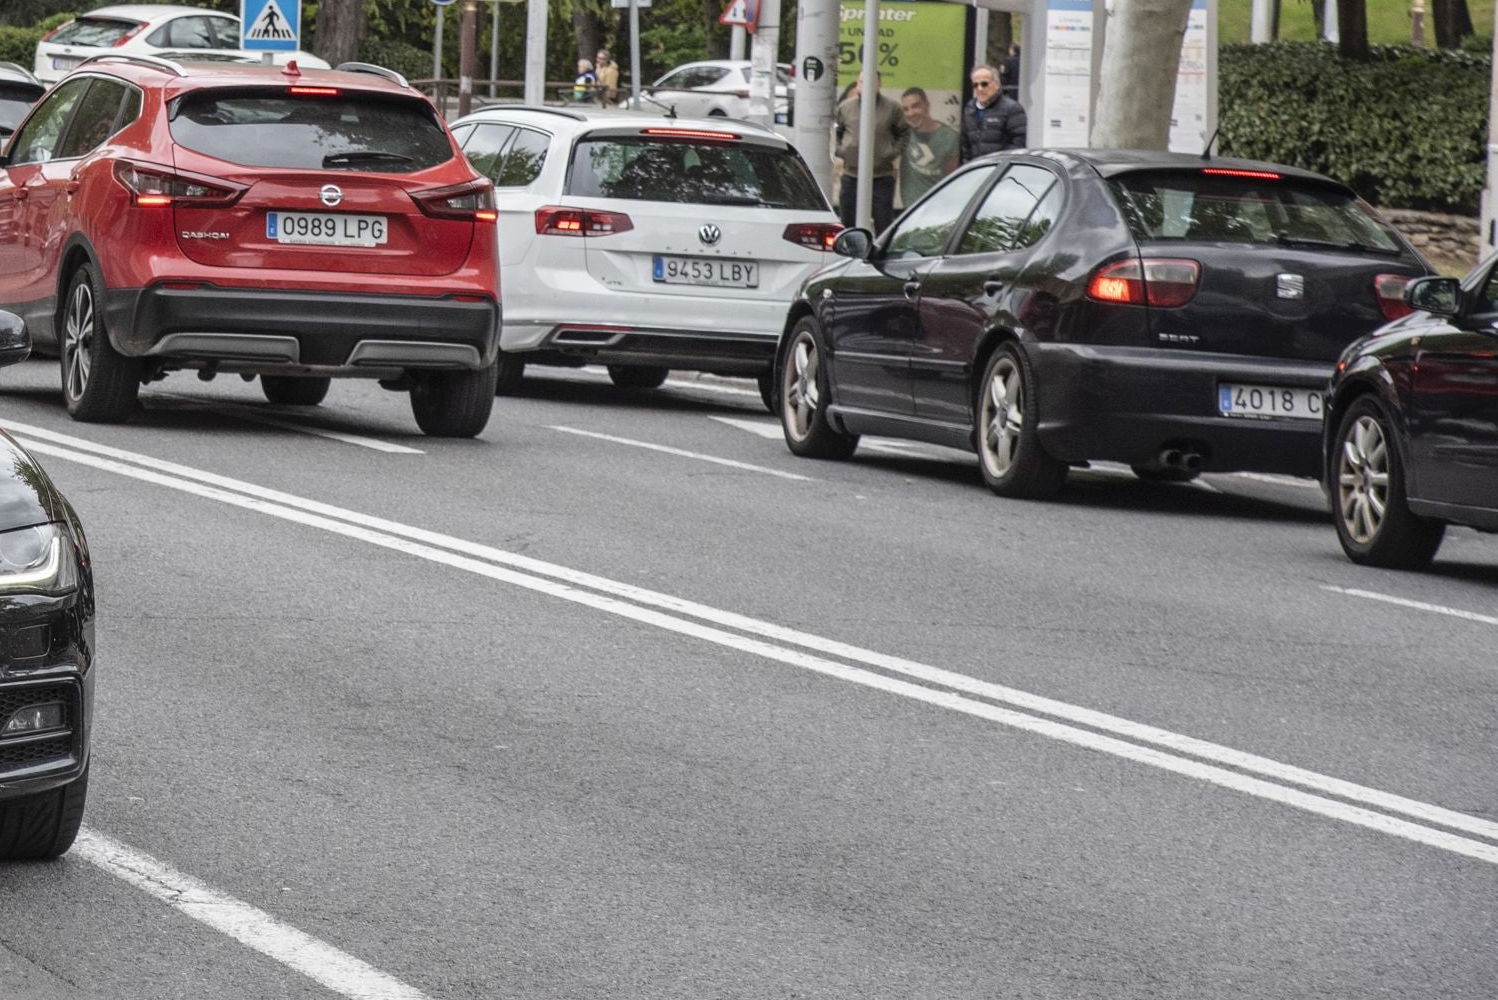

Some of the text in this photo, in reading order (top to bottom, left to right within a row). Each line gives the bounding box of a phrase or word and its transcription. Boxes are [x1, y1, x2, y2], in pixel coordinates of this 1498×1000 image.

[283, 216, 336, 237] 0989
[344, 218, 383, 240] LPG
[667, 261, 753, 282] 9453 LBY
[1235, 387, 1294, 412] 4018
